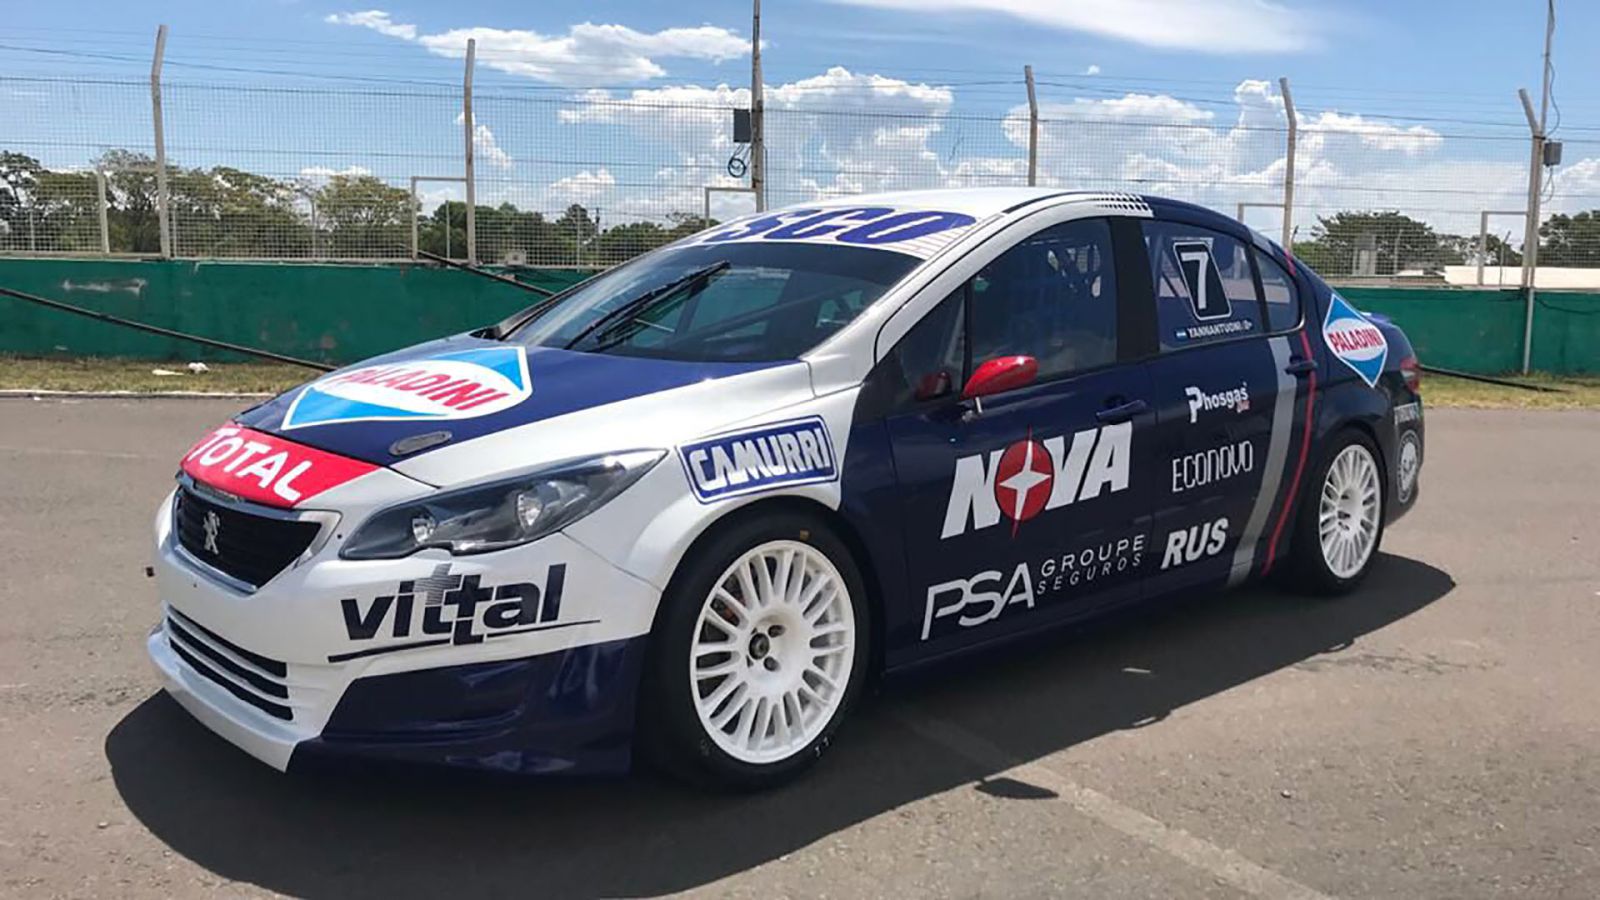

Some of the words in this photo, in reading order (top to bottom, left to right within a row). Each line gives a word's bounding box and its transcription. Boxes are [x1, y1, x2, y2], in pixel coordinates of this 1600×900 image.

[1180, 252, 1209, 310] 7
[1329, 326, 1385, 353] PALADINI
[325, 366, 509, 410] PALADINI
[1185, 383, 1249, 424] Phosgas
[189, 427, 313, 501] TOTAL
[690, 428, 831, 491] CAMURRI
[1160, 517, 1229, 570] RUS
[921, 562, 1035, 641] PSA
[1041, 534, 1146, 577] GROUPE
[1036, 552, 1142, 596] SEGUROS
